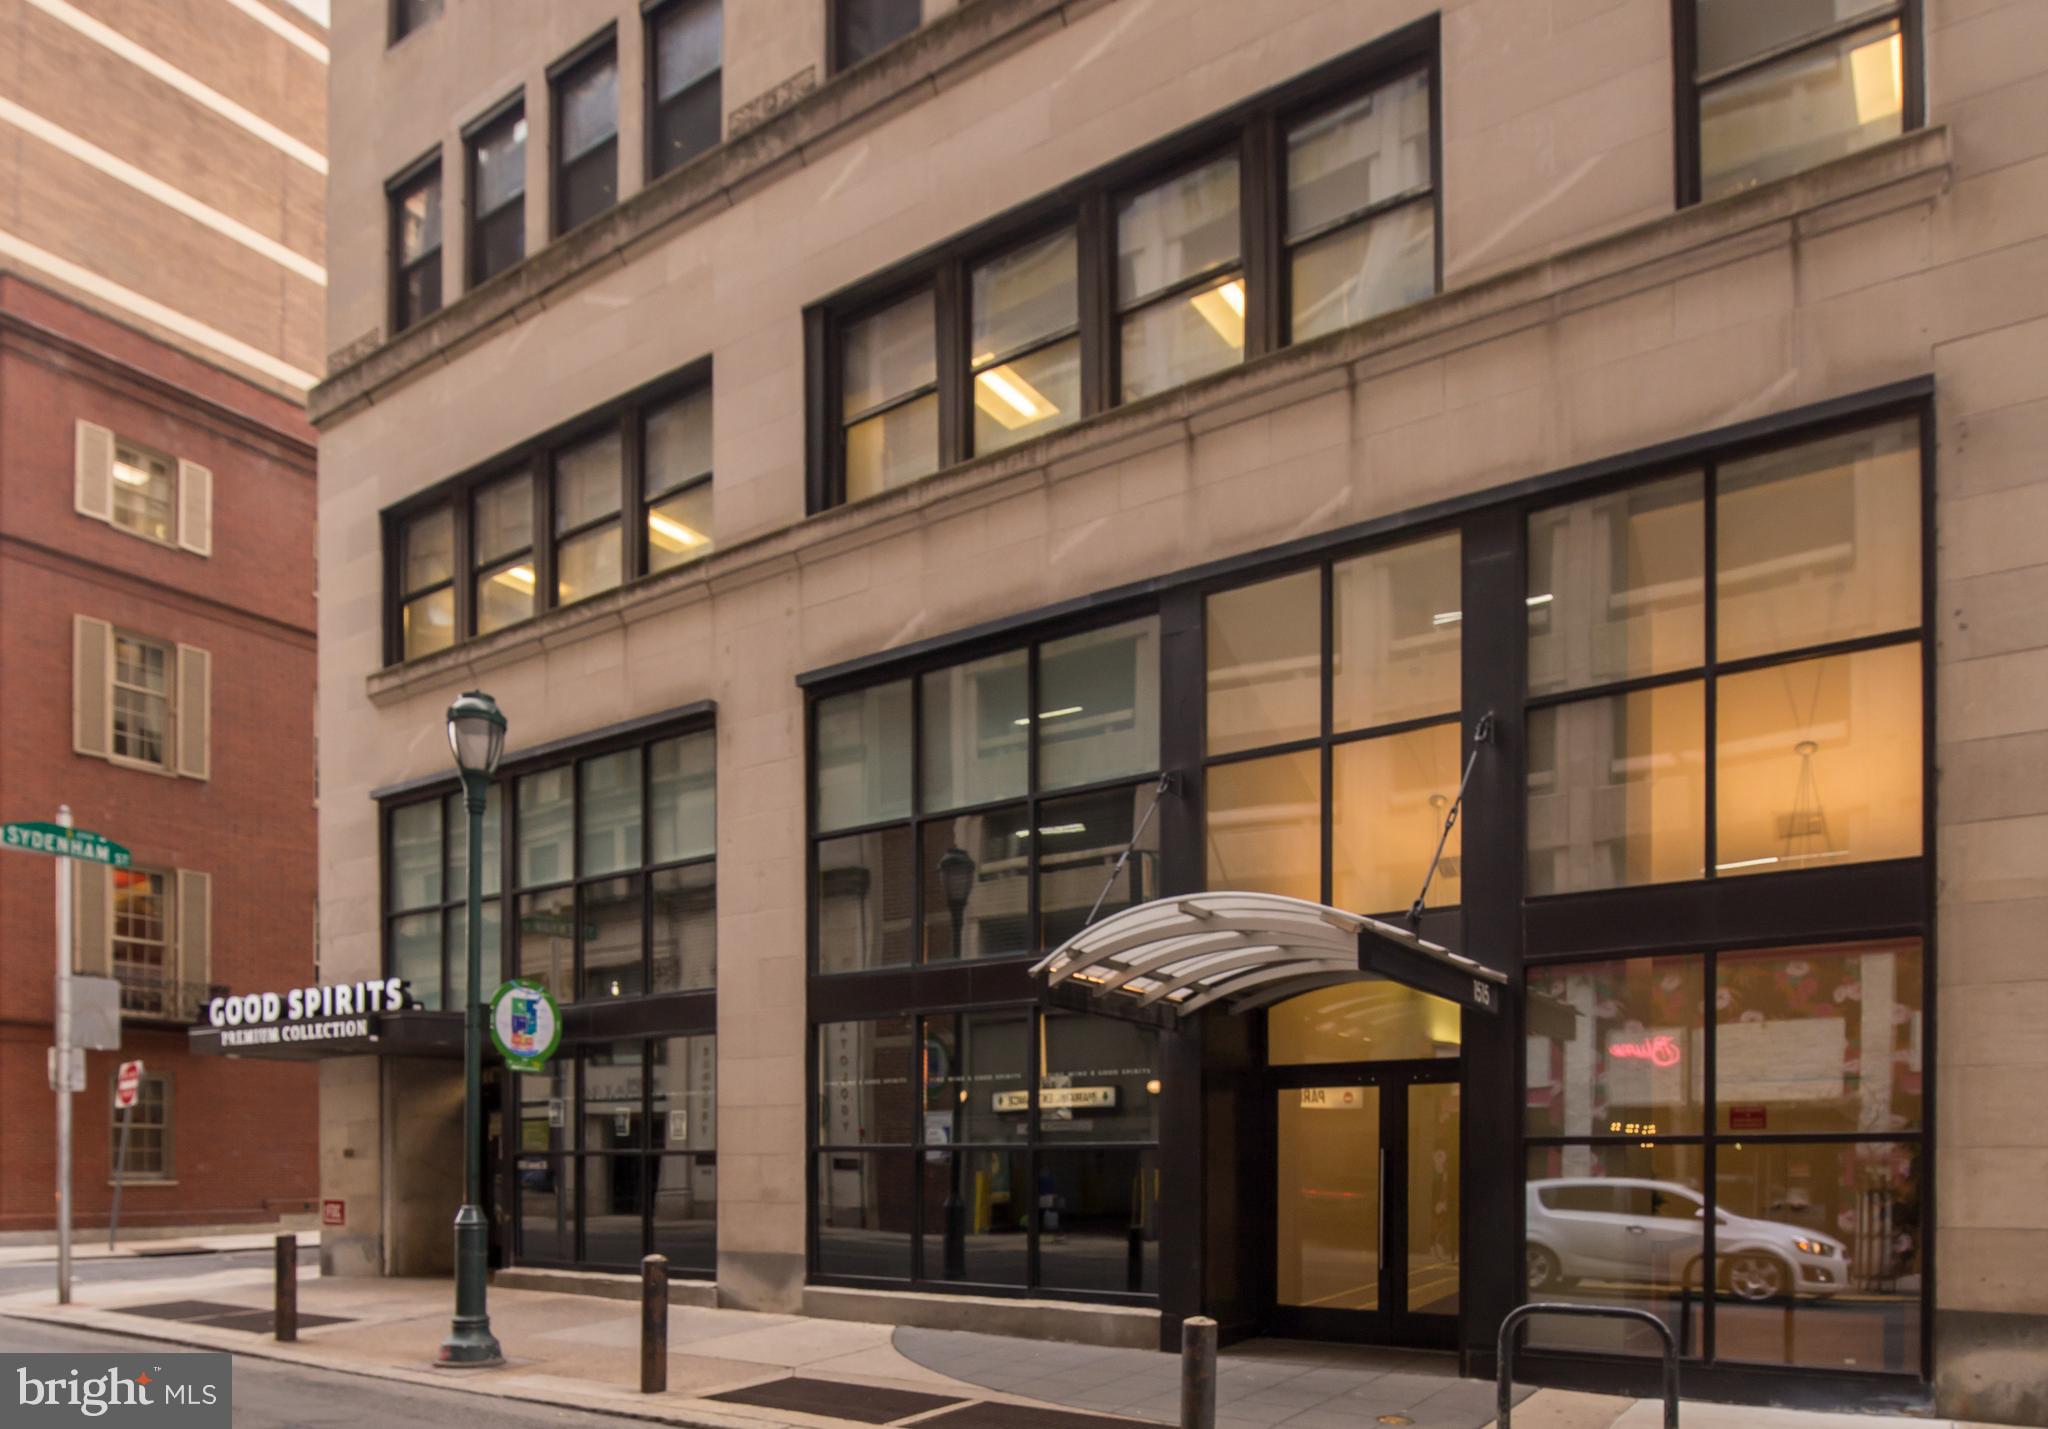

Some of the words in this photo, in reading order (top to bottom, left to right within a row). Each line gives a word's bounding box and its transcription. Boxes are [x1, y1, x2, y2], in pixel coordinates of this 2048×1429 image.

[8, 825, 110, 861] SYDENHAM
[209, 991, 281, 1027] GOOD
[288, 977, 403, 1020] SPIRITS
[221, 1026, 280, 1047] PREMIUM
[281, 1018, 368, 1043] COLLECTION
